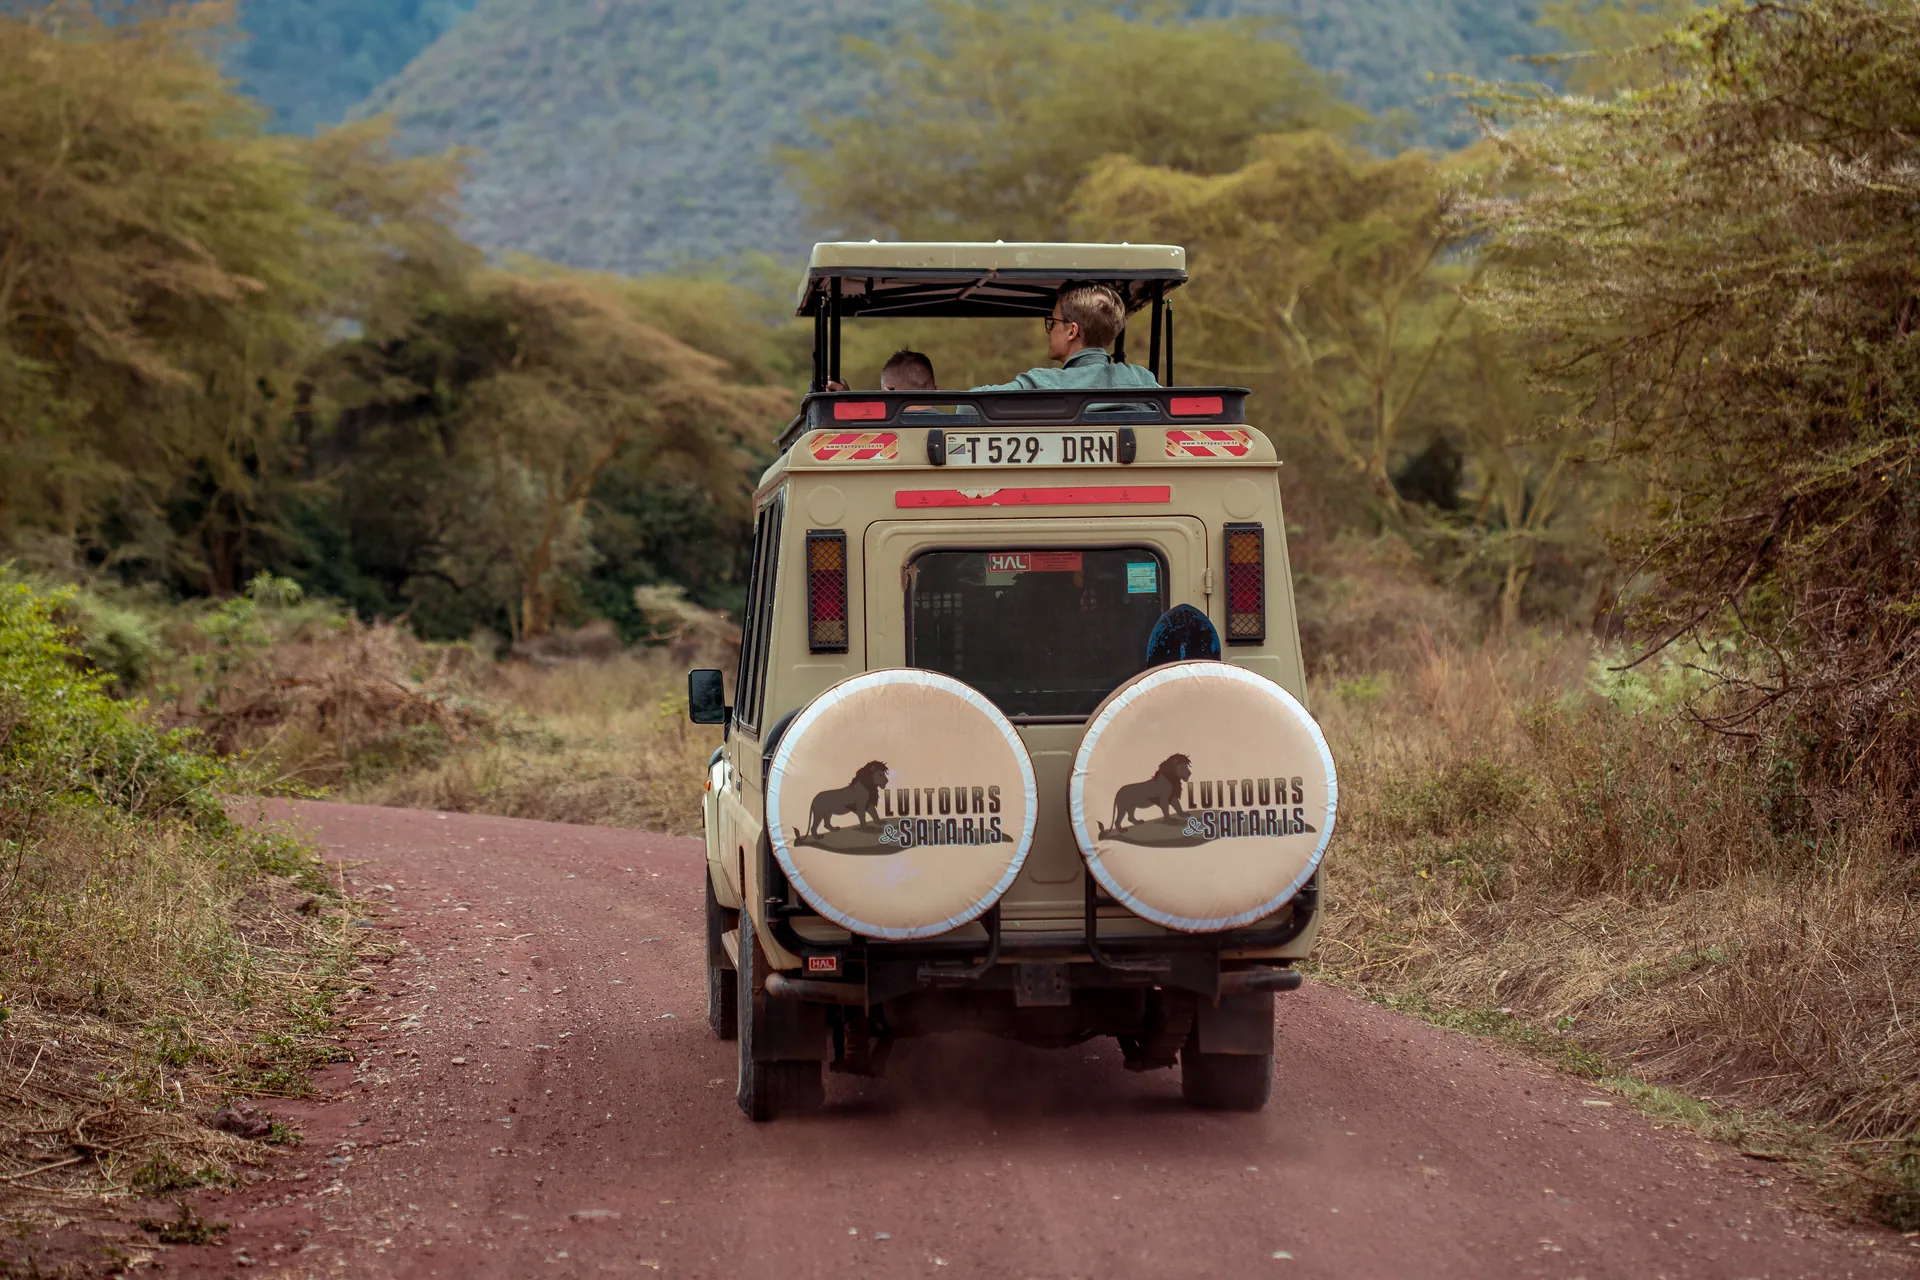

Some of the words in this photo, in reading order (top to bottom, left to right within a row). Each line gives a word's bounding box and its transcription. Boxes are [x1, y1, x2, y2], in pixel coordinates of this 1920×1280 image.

[966, 437, 981, 464] T
[988, 437, 1040, 464] 529
[1062, 436, 1114, 463] DRN
[992, 555, 1026, 569] HAL
[884, 785, 1001, 817] LUITOURS
[1187, 776, 1304, 809] LUITOURS
[812, 959, 833, 968] HAL
